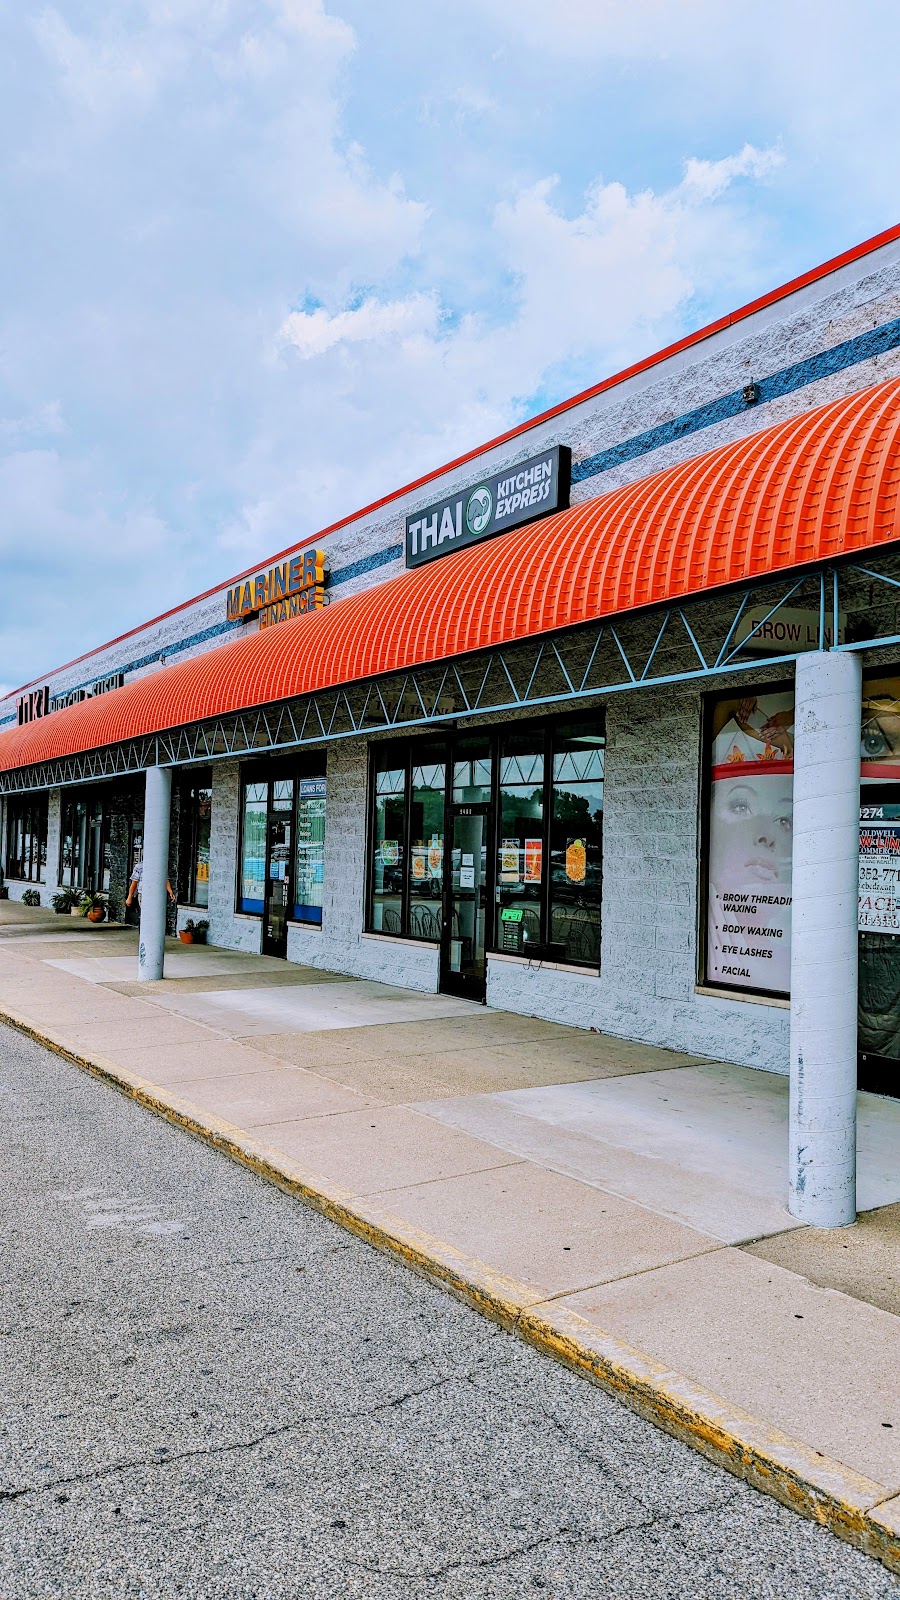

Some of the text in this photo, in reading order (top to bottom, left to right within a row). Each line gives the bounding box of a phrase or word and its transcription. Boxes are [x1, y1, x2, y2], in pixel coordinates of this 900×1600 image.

[496, 459, 553, 499] KITCHEN
[494, 479, 552, 520] EXPRESS
[408, 500, 463, 556] THAI
[226, 548, 323, 621] MARINER
[259, 585, 323, 630] FINANCE
[751, 620, 802, 642] BROW
[92, 673, 124, 697] SUSHI
[375, 700, 406, 713] THAI
[301, 783, 326, 794] LOANS FOR
[877, 836, 900, 850] LIN
[722, 893, 750, 903] BROW
[723, 903, 757, 914] WAXING
[722, 924, 783, 938] BODY WAXING
[721, 945, 773, 959] EYE LASHES
[721, 966, 751, 977] FACIAL
